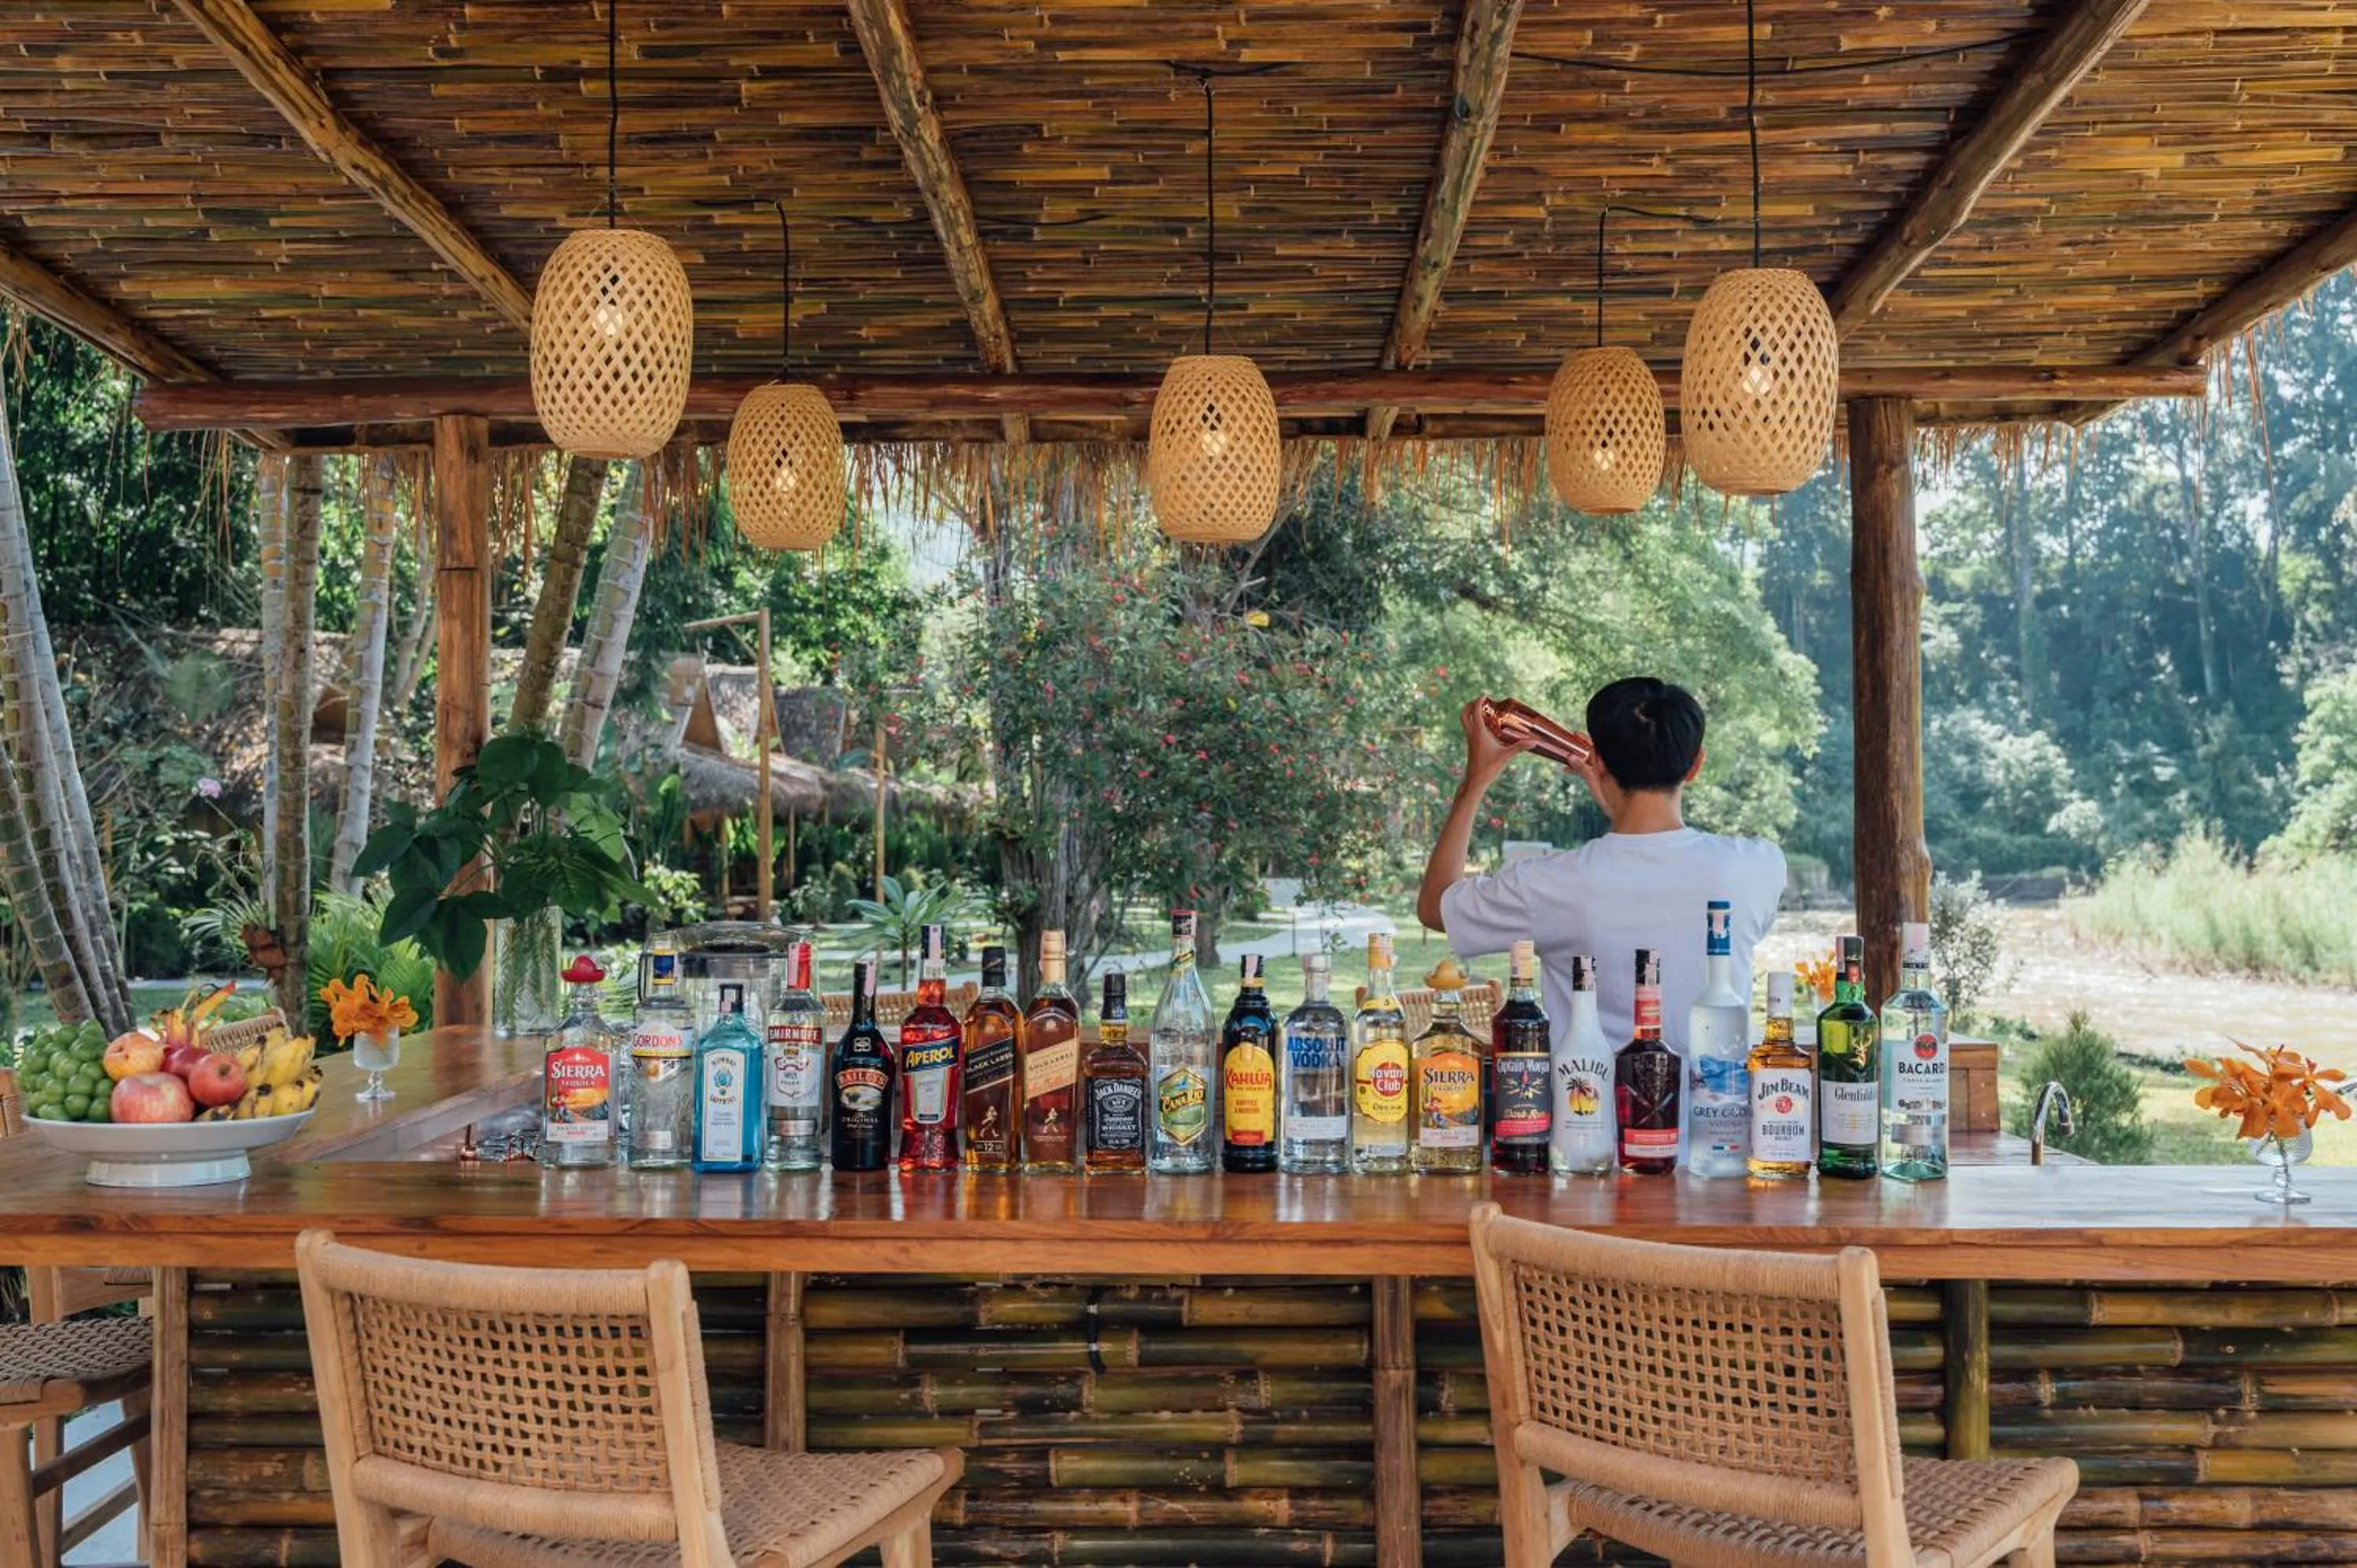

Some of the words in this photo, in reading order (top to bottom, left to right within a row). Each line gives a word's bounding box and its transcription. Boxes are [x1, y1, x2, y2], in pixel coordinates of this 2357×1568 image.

[769, 1028, 818, 1039] SMIRNOFF
[1287, 1036, 1345, 1052] ABSOLUT
[906, 1046, 954, 1069] APEROL
[1292, 1052, 1342, 1068] VODKA
[552, 1060, 606, 1079] SIERRA
[1370, 1068, 1407, 1079] Havana
[1424, 1068, 1475, 1084] SIERRA
[1558, 1058, 1609, 1082] MALIBU
[1376, 1079, 1402, 1092] Club
[1758, 1082, 1780, 1101] JIM
[1781, 1077, 1809, 1101] BEAM
[1693, 1105, 1717, 1118] GREY
[1762, 1124, 1805, 1136] BOURBON
[984, 1141, 994, 1152] 12
